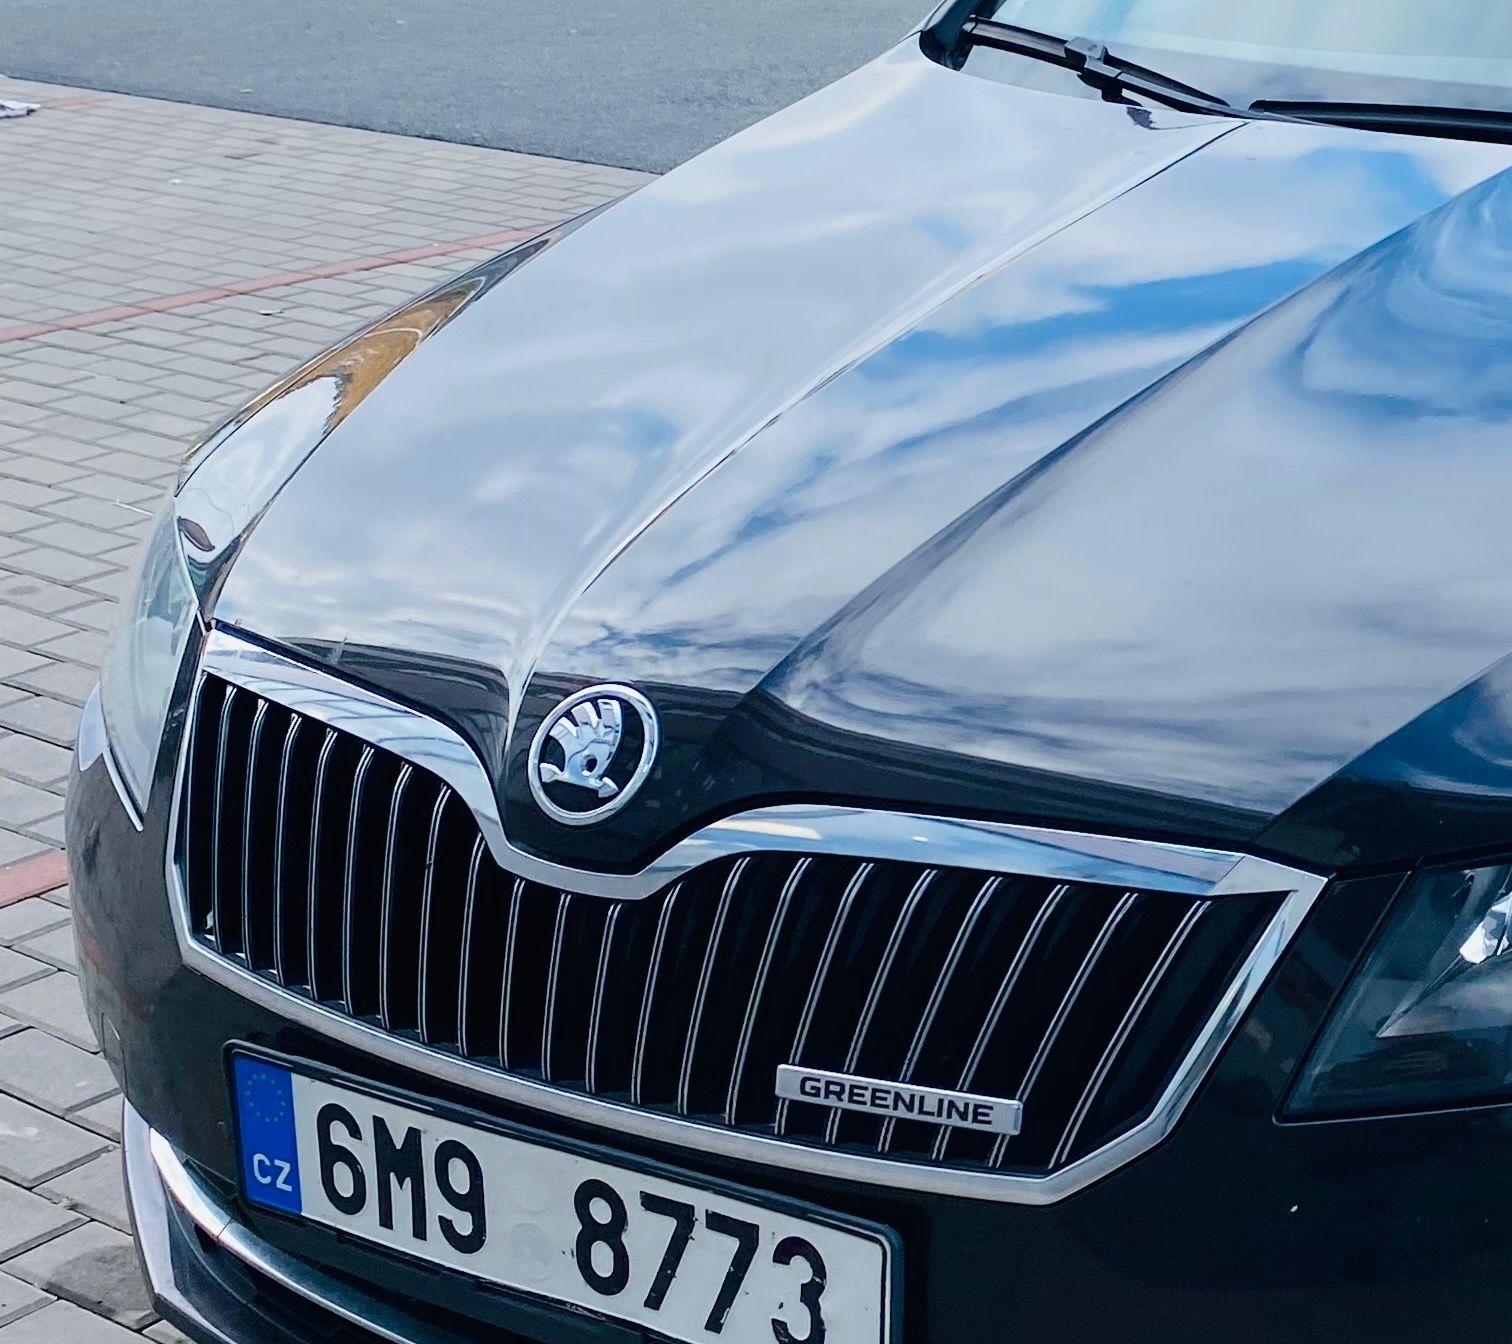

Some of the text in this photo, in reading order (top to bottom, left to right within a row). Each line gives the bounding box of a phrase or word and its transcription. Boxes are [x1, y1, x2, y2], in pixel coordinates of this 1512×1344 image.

[799, 1075, 995, 1126] GREENLINE
[252, 1152, 294, 1193] CZ
[315, 1102, 488, 1255] 6M9
